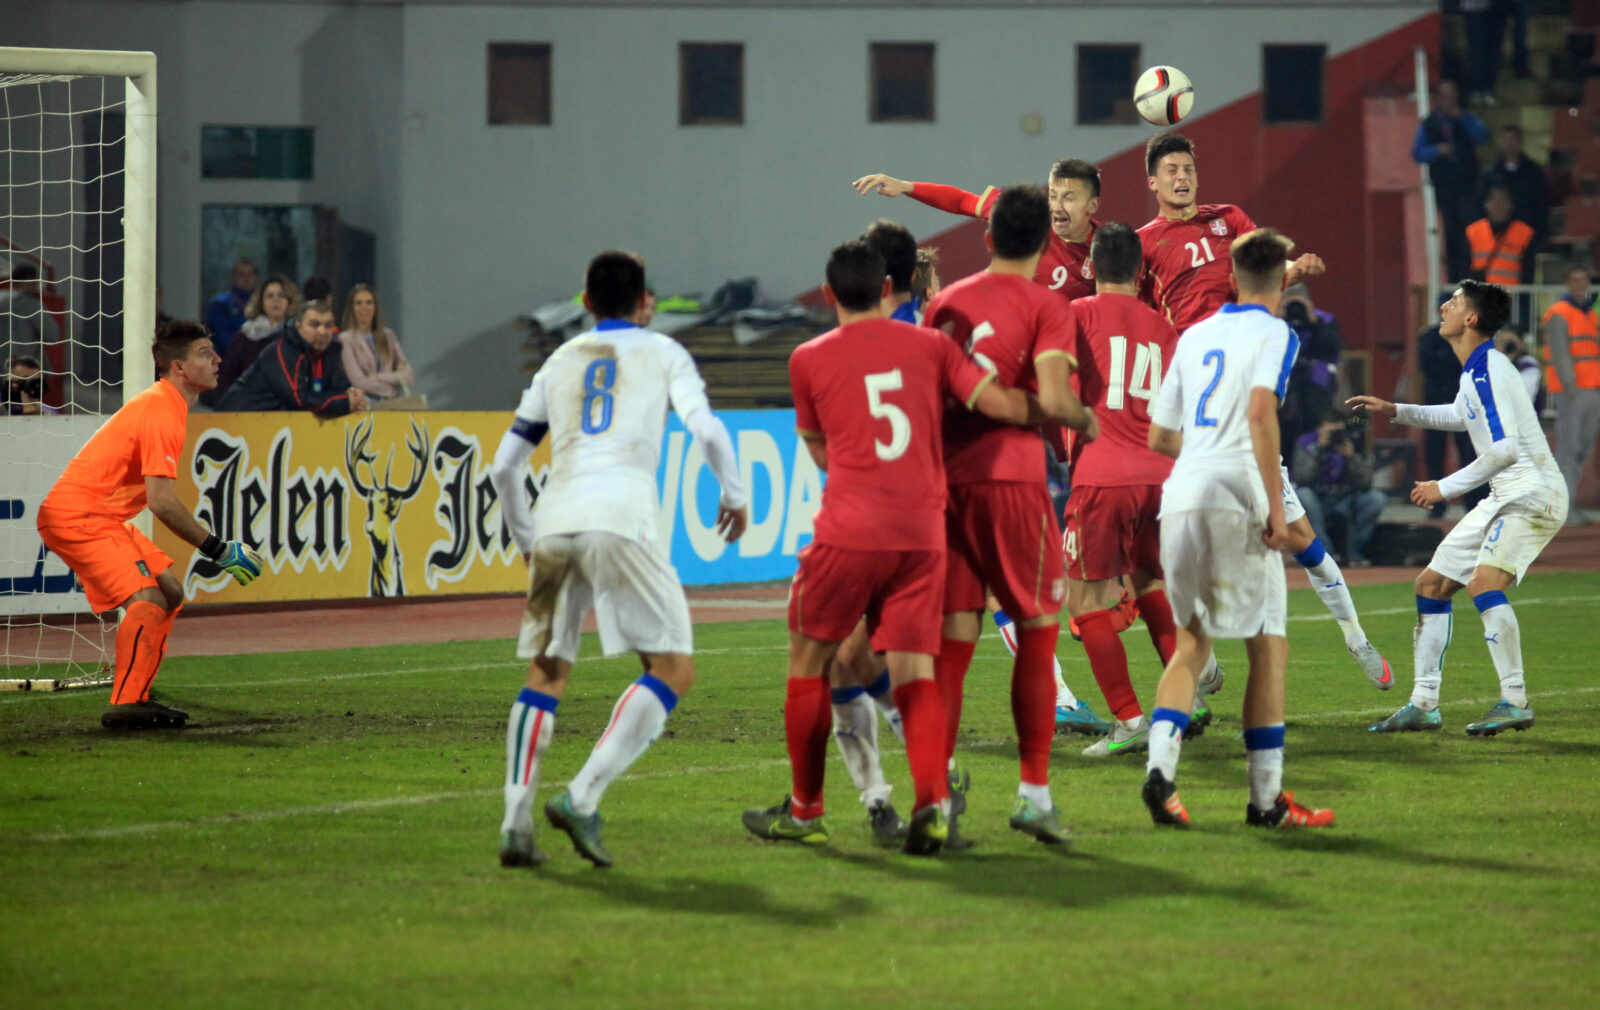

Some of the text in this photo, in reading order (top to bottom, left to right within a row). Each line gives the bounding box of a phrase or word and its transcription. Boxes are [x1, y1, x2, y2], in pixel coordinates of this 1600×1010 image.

[1047, 265, 1068, 290] 9
[1184, 236, 1215, 269] 21
[581, 358, 618, 435] 8
[865, 368, 912, 461] 5
[1106, 335, 1162, 417] 14
[1195, 349, 1225, 427] 2
[185, 428, 350, 600] Jelen
[1487, 518, 1505, 543] 3
